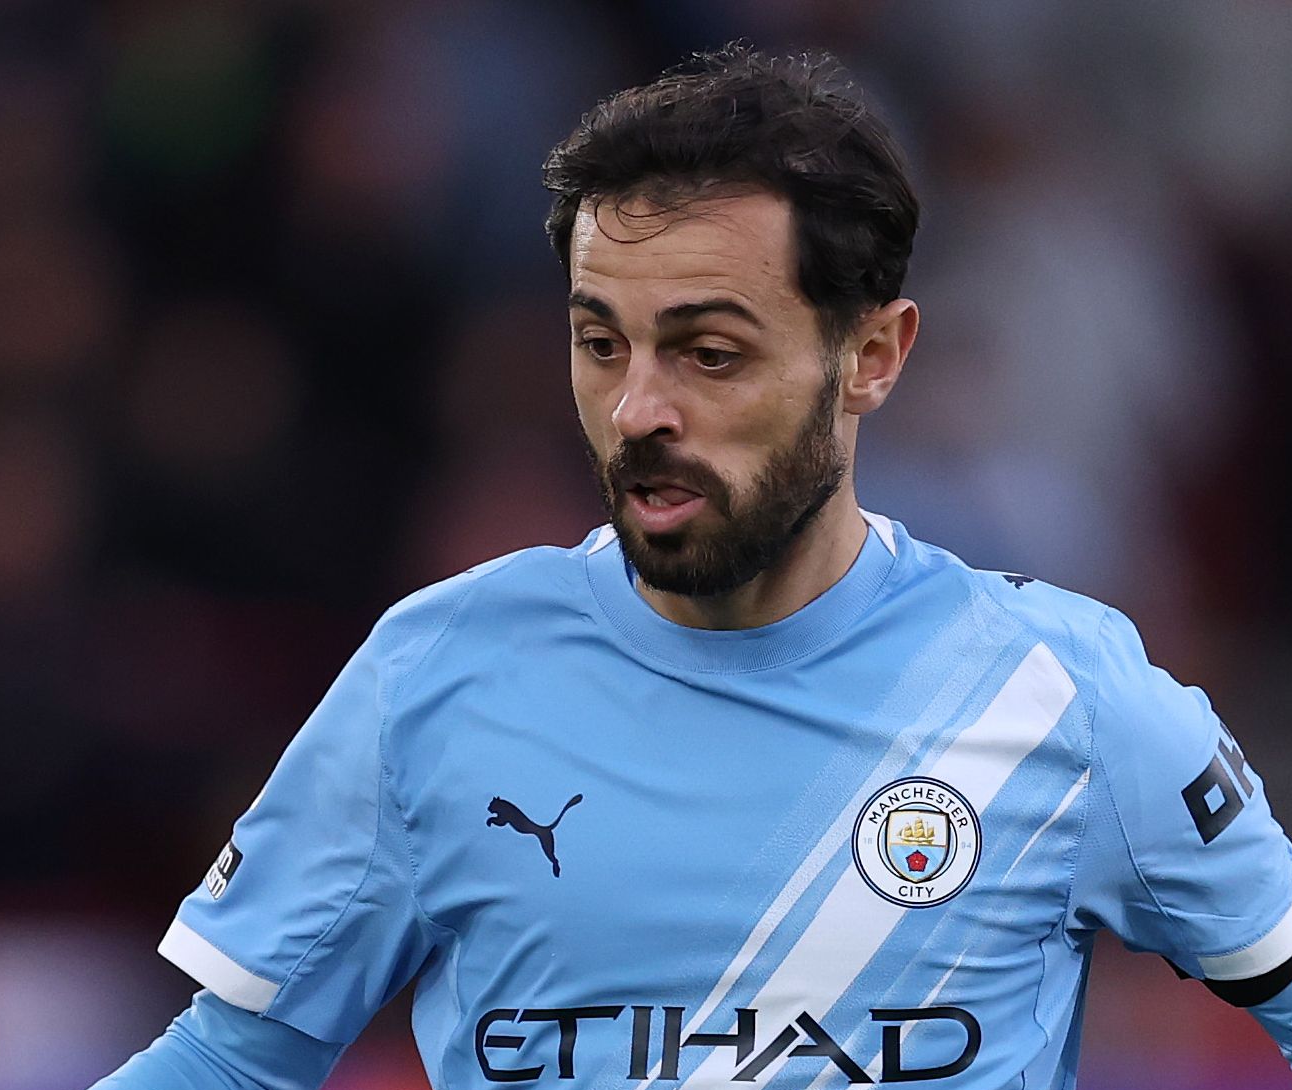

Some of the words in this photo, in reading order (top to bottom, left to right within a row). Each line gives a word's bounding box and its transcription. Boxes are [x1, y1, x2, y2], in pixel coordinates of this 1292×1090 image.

[868, 787, 969, 829] MANCHESTER
[898, 885, 935, 898] CITY
[474, 1004, 982, 1084] ETIHAD
